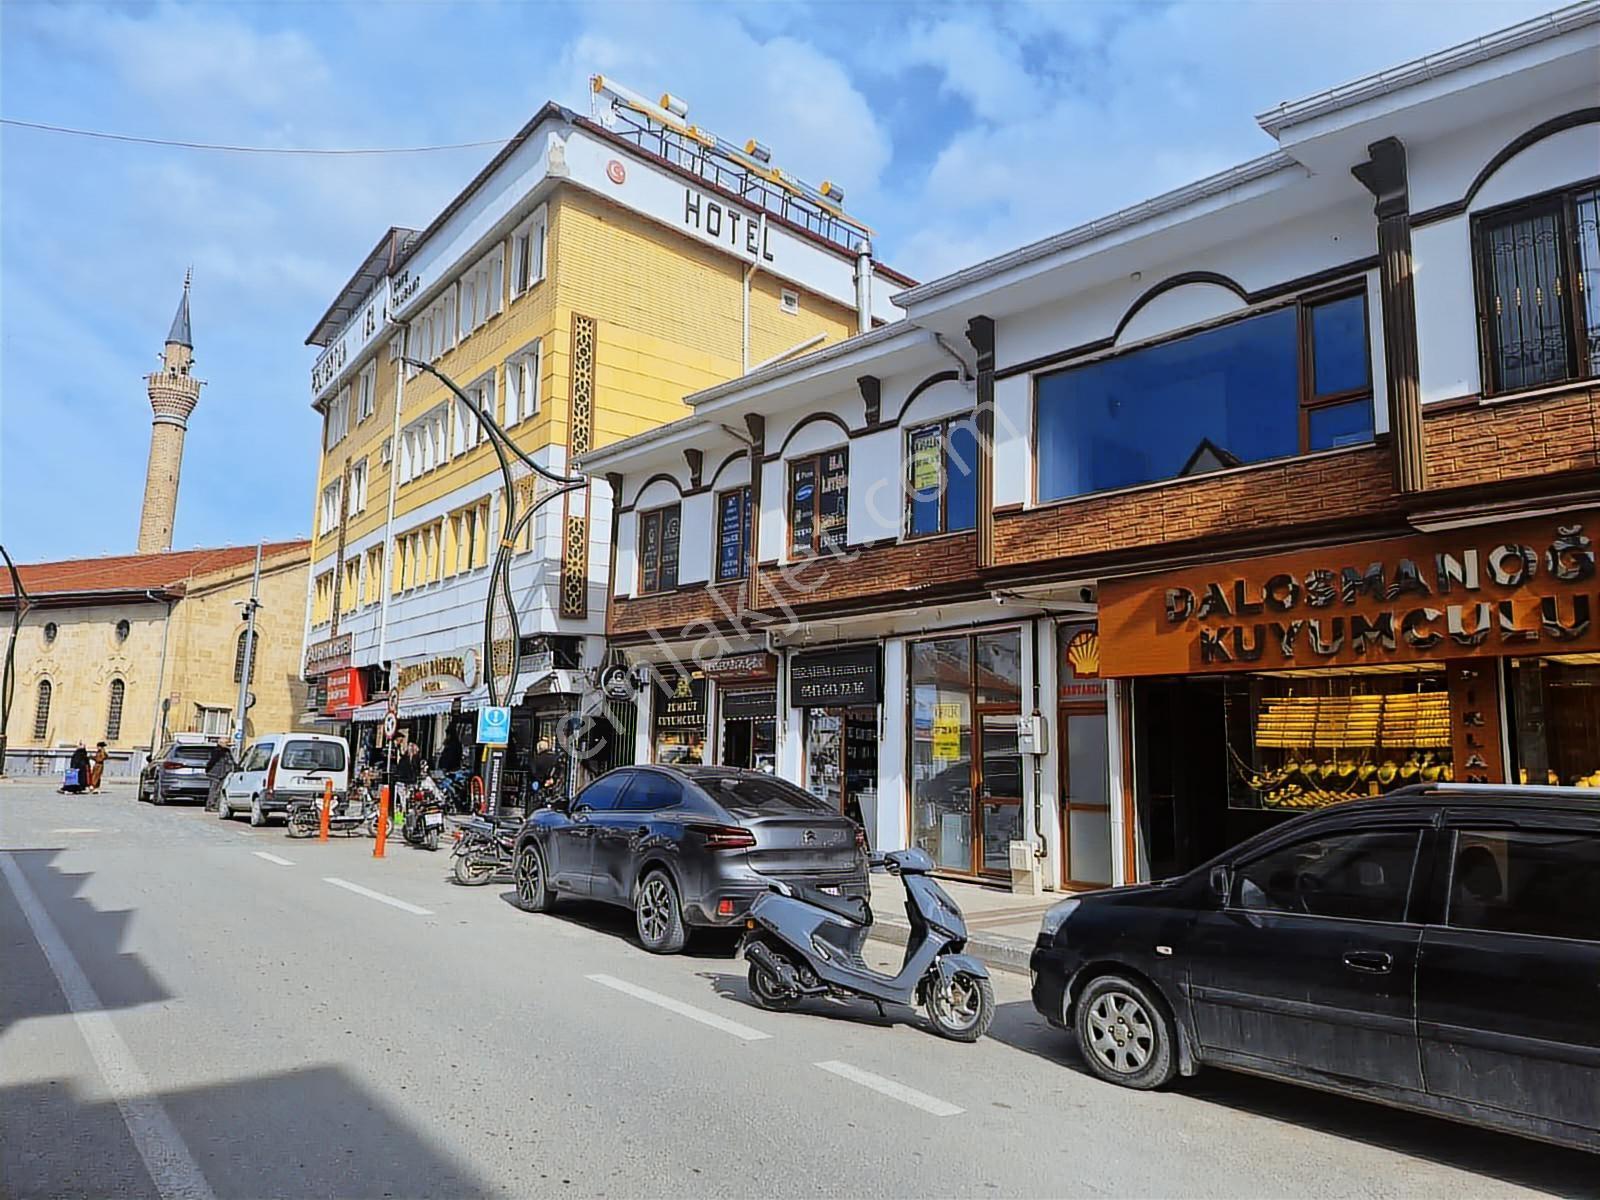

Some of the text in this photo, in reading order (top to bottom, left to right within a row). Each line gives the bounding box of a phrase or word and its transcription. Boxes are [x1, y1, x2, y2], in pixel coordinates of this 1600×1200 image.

[685, 189, 774, 262] HOTEL
[1165, 524, 1597, 623] DALOSMANOĞ
[1201, 594, 1592, 665] KUYUMCULU
